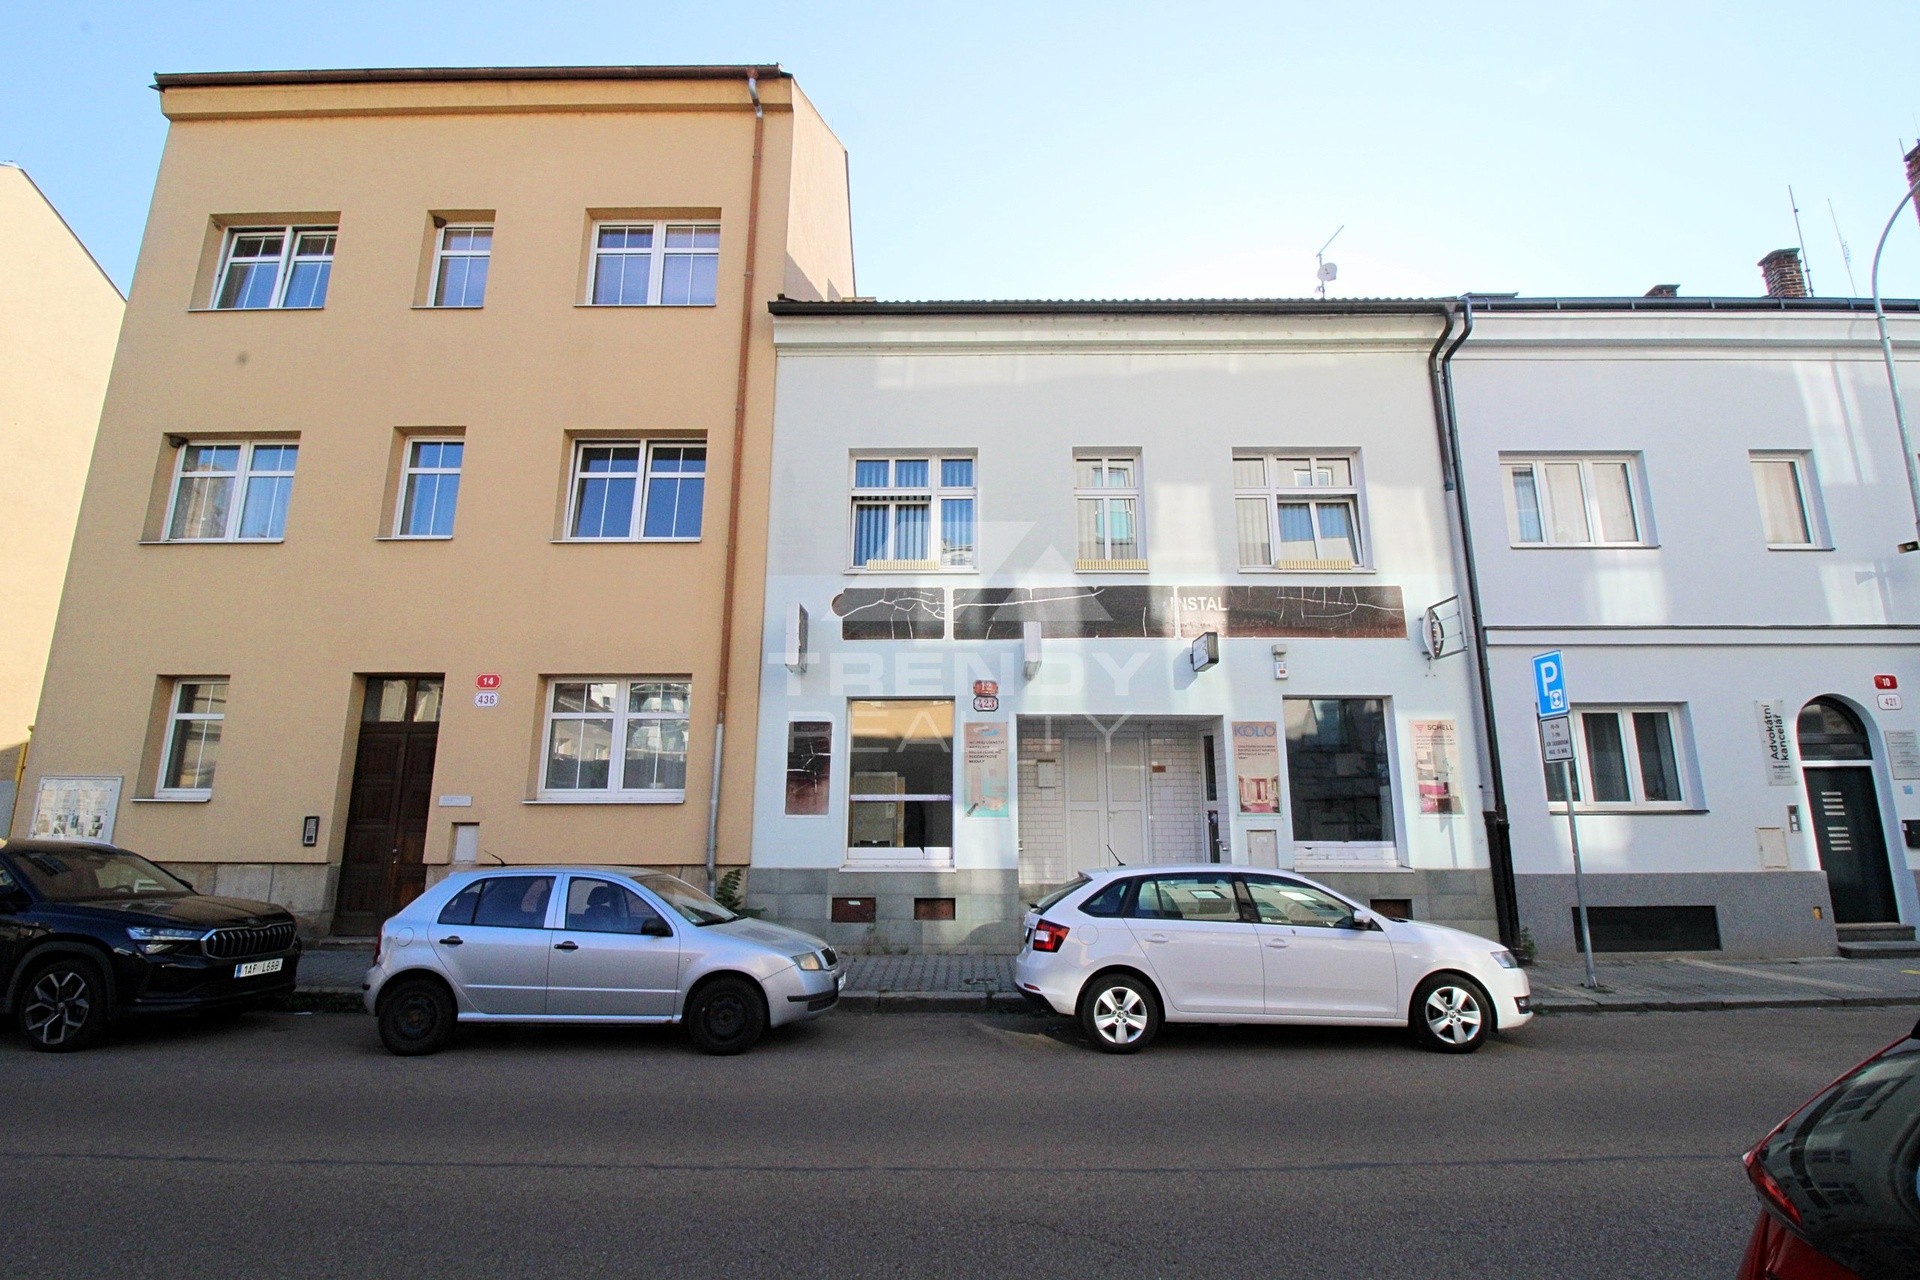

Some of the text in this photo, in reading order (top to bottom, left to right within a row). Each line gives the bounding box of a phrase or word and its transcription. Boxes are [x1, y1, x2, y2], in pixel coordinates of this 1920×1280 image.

[483, 677, 494, 685] 14
[1540, 660, 1558, 697] P
[1882, 677, 1891, 687] 10
[478, 695, 495, 704] 436
[977, 699, 995, 708] 423
[1885, 697, 1897, 706] 421
[1234, 725, 1276, 737] KOLO
[1761, 704, 1780, 760] Advokátní
[1773, 714, 1789, 761] kancelář
[244, 963, 257, 975] 1AF
